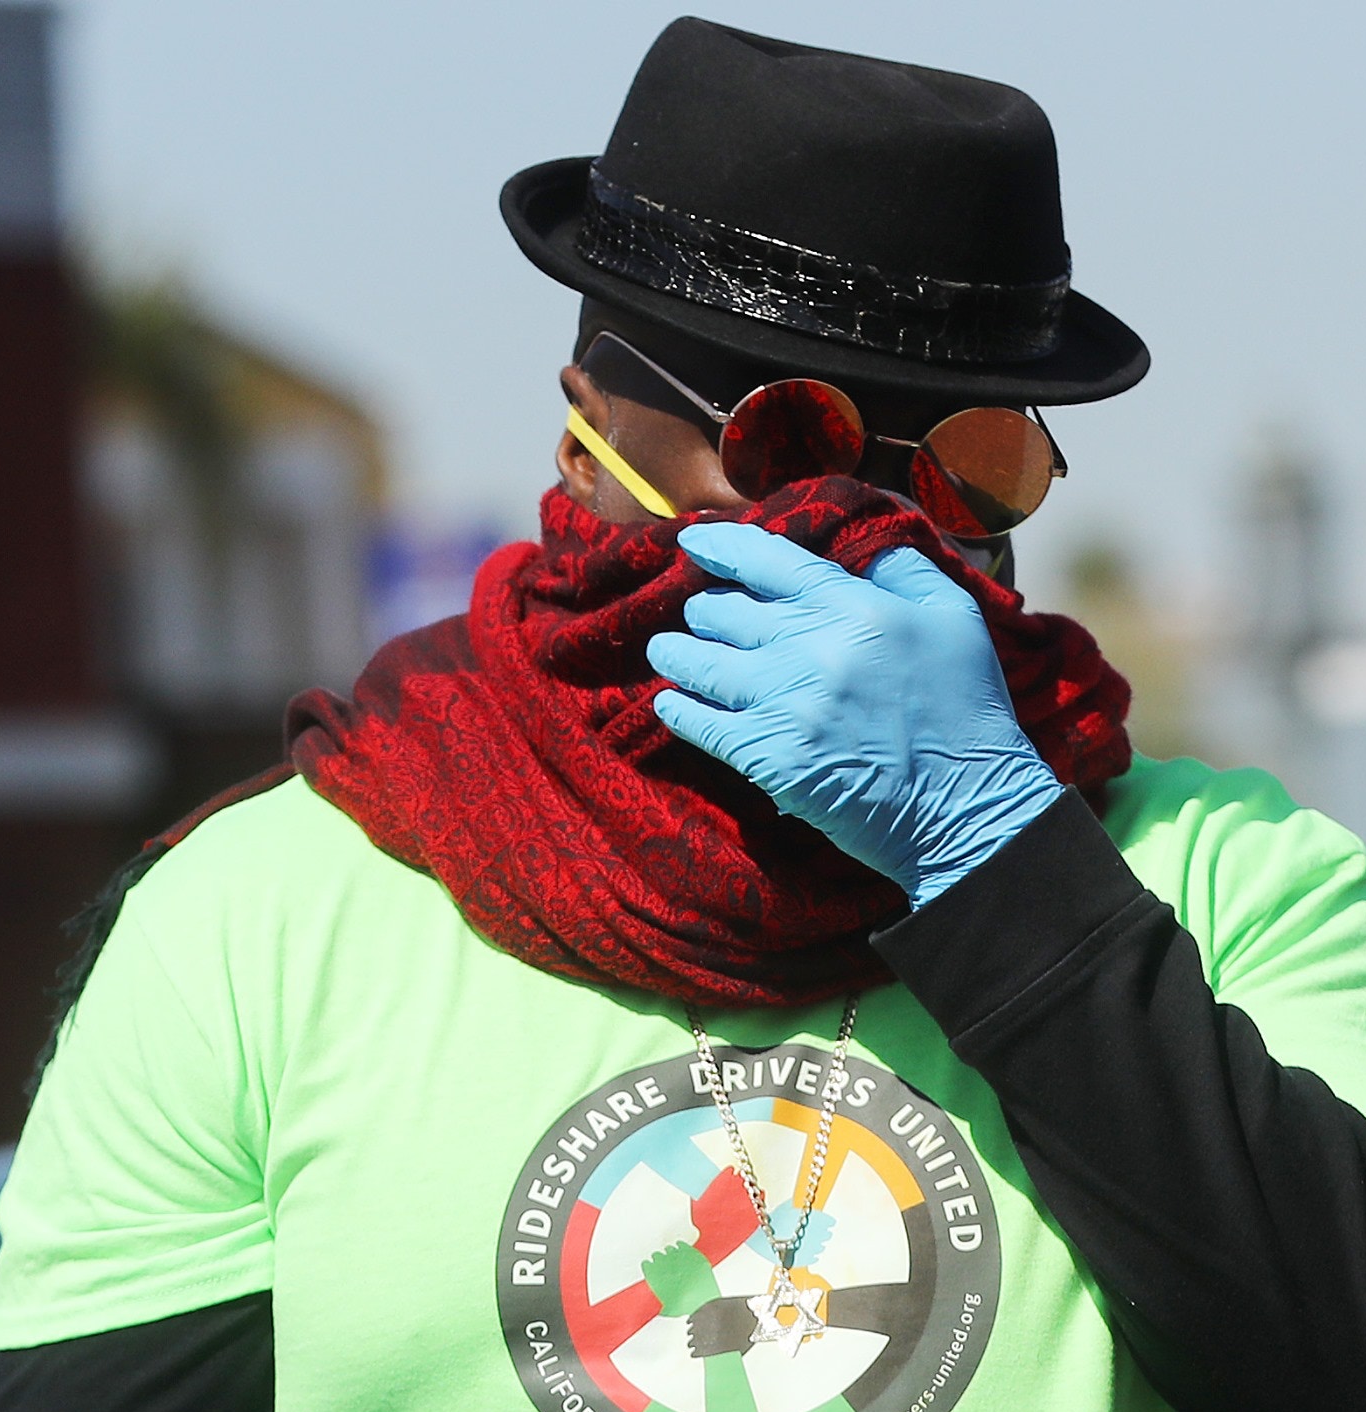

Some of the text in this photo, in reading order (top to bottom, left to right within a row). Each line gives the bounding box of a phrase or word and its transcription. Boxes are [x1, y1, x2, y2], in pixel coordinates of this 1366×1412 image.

[512, 1056, 984, 1286] RIDESHARE DRIVERS UNITED
